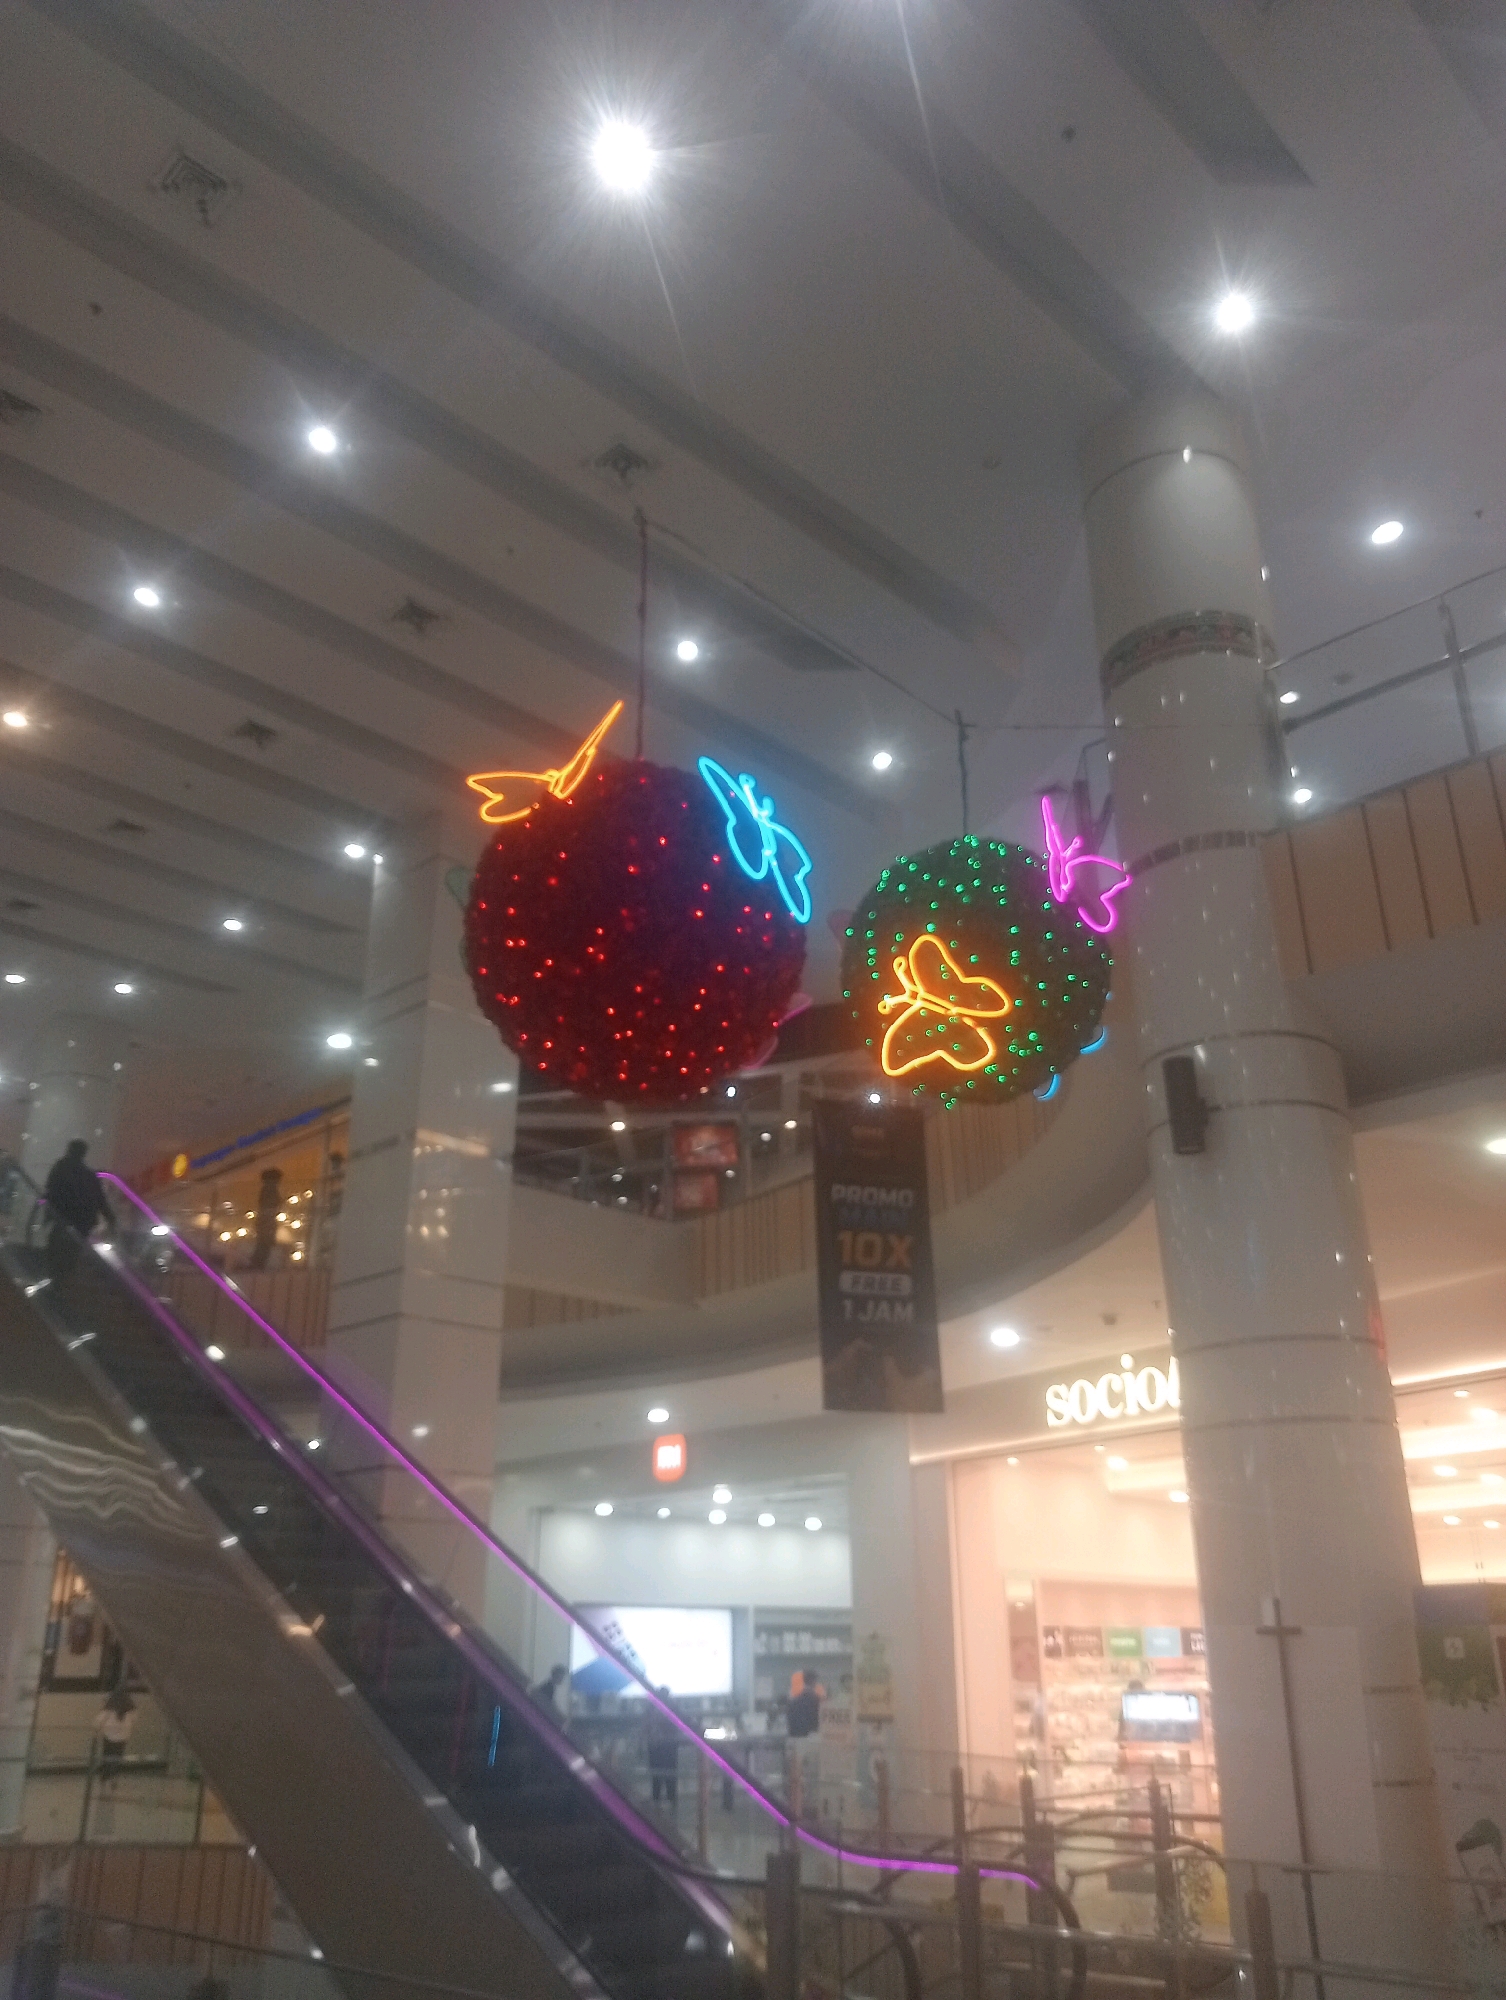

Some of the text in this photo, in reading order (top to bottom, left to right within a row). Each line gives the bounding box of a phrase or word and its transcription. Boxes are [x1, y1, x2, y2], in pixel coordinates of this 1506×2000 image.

[831, 1183, 915, 1208] PROMO
[838, 1229, 914, 1269] 10X
[850, 1273, 903, 1293] FREE
[857, 1299, 914, 1324] JAM
